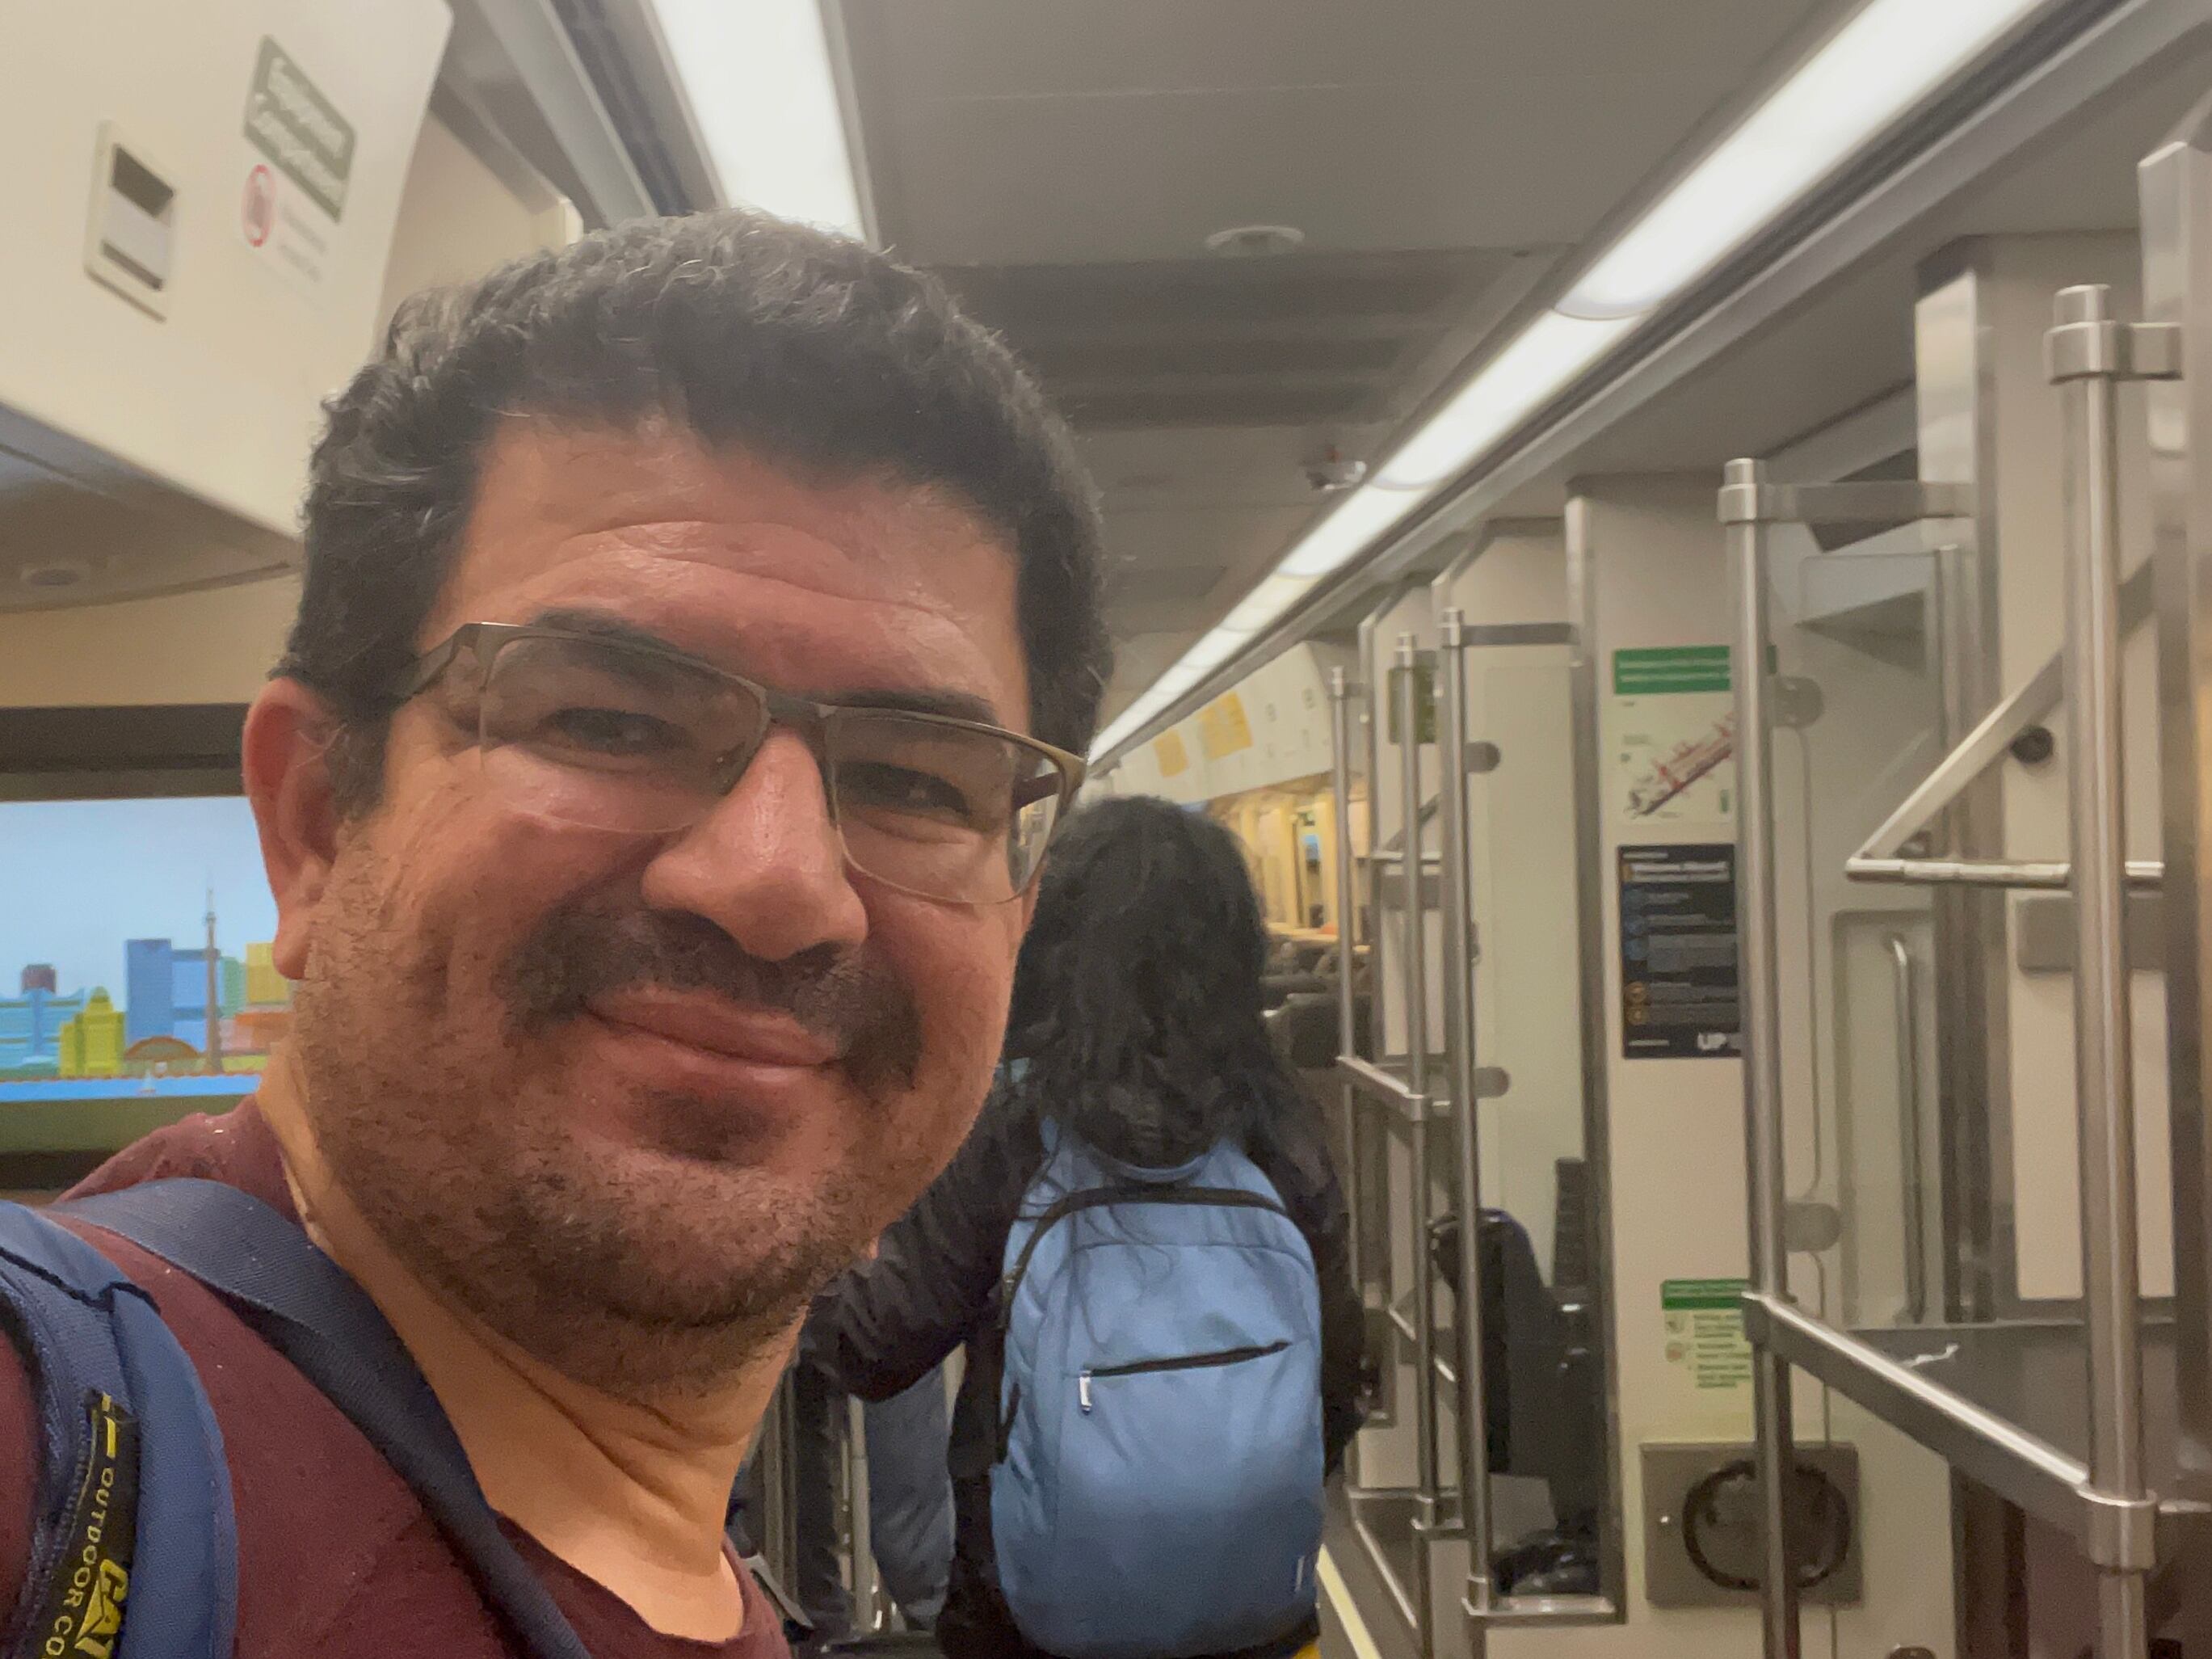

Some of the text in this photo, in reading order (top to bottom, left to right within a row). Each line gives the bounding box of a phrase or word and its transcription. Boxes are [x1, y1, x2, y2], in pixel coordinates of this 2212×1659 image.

[41, 1467, 114, 1659] OUTDOOR CO
[74, 1559, 128, 1659] CAT
